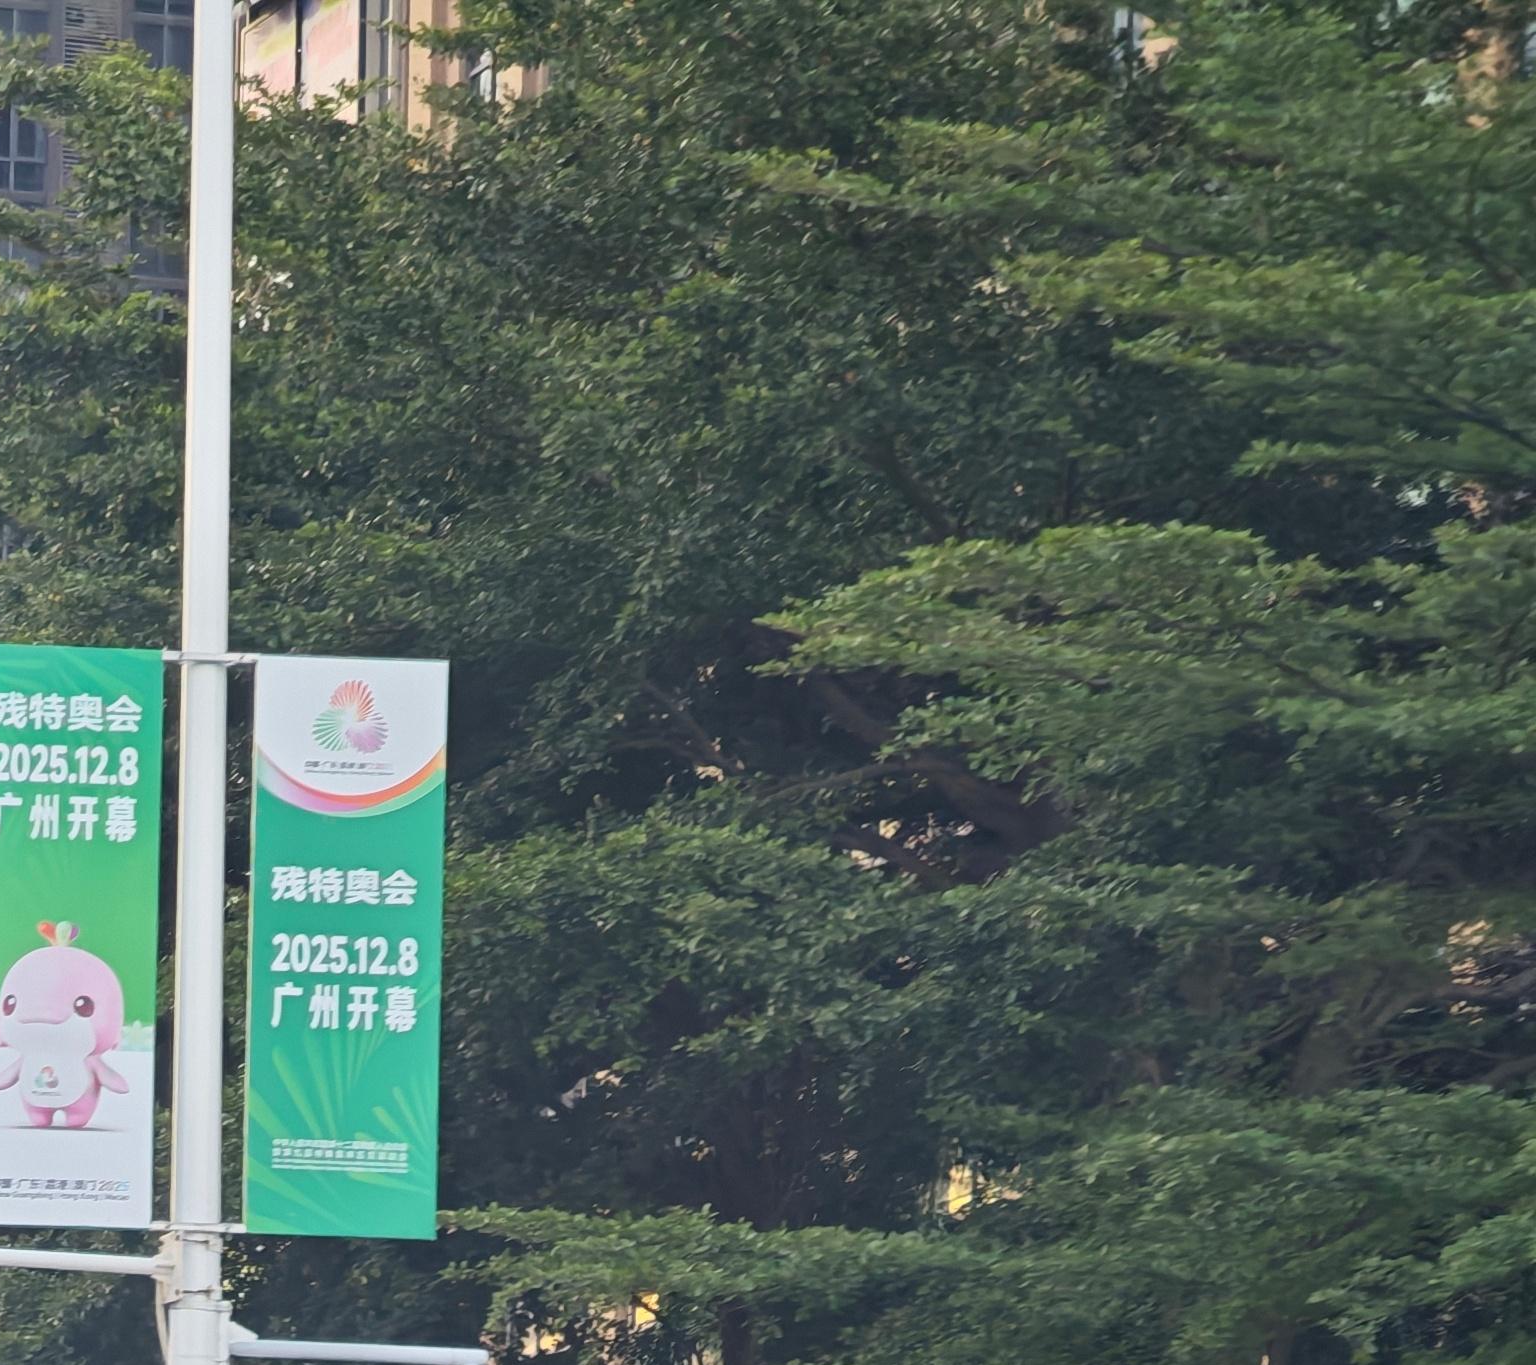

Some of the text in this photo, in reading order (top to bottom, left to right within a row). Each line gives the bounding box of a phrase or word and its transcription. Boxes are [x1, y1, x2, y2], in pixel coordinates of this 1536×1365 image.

[270, 866, 418, 905] 残特奥会
[270, 933, 419, 976] 2025.12.8
[270, 982, 417, 1032] 广州开幕
